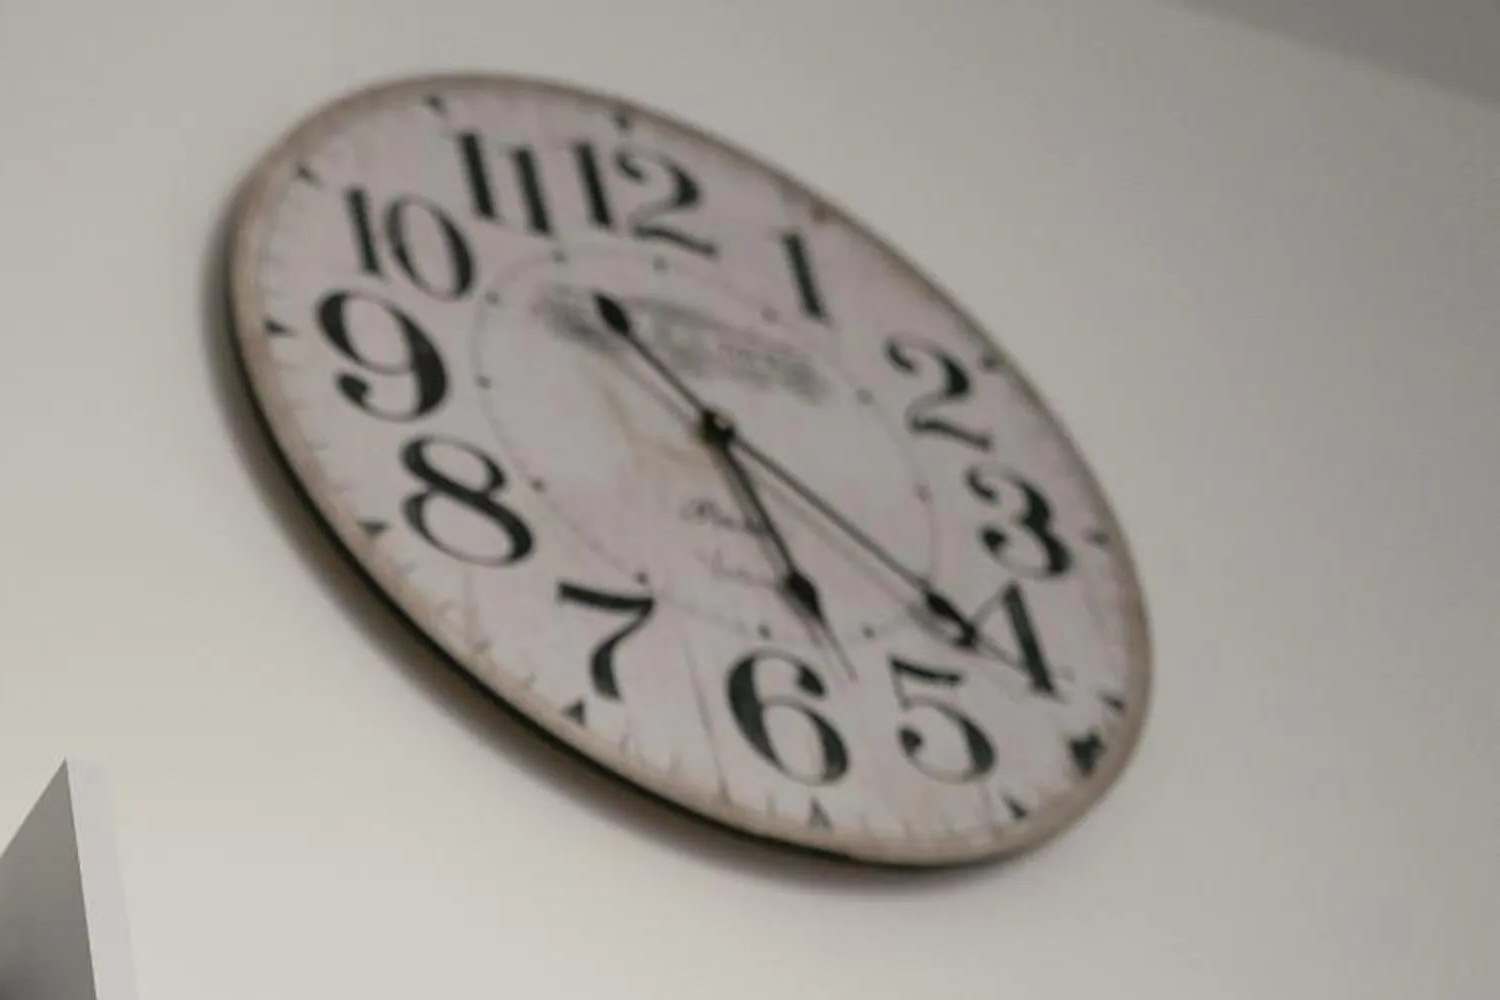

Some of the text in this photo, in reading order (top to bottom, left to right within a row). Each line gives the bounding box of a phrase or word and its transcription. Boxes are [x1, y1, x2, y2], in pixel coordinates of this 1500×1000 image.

[457, 128, 552, 238] 11
[573, 138, 719, 259] 12
[344, 187, 477, 302] 10
[781, 230, 829, 323] 1
[313, 288, 449, 424] 9
[884, 333, 993, 454] 2
[398, 432, 534, 568] 8
[964, 465, 1072, 580] 3
[556, 579, 656, 702] 7
[964, 580, 1069, 703] 4
[726, 647, 849, 788] 6
[887, 652, 996, 785] 5
